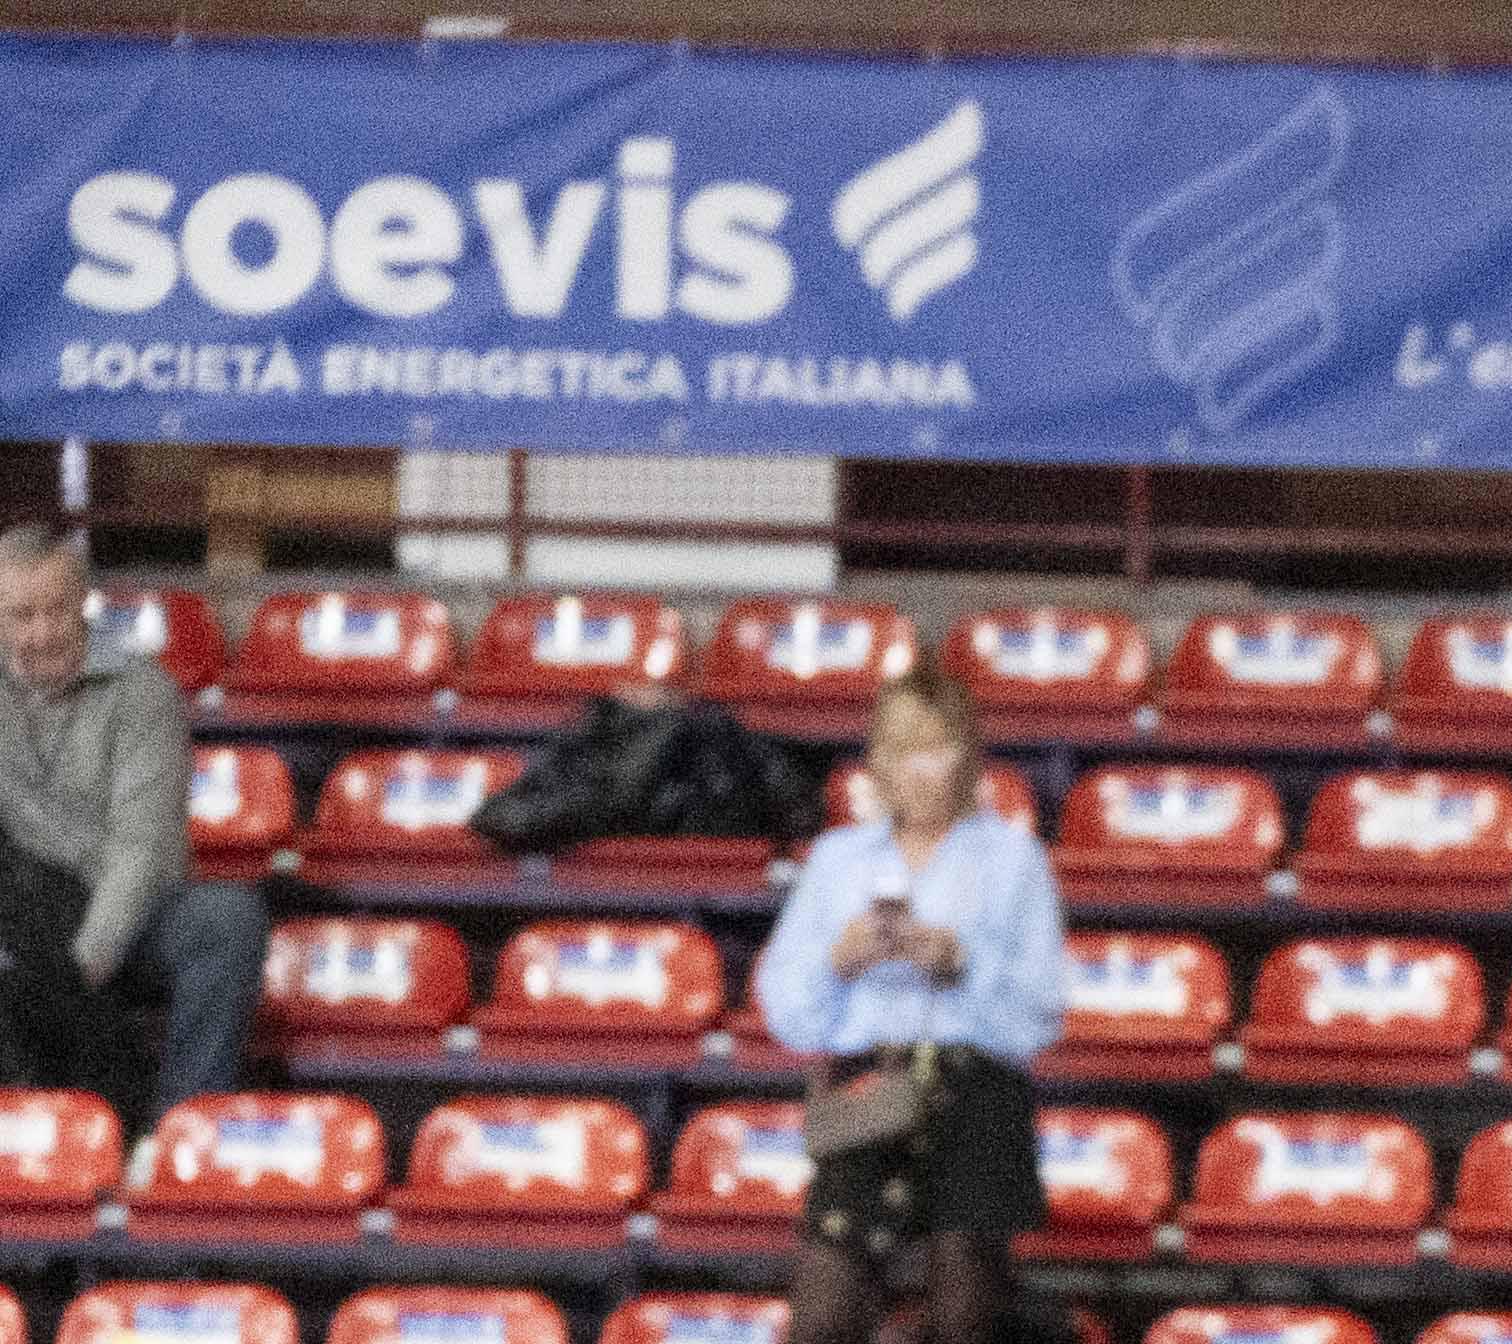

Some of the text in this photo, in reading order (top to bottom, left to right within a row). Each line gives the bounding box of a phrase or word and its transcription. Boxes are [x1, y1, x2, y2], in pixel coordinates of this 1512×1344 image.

[66, 138, 793, 324] soevis
[322, 346, 688, 401] ENERGETICA
[706, 354, 978, 409] ITALIANA
